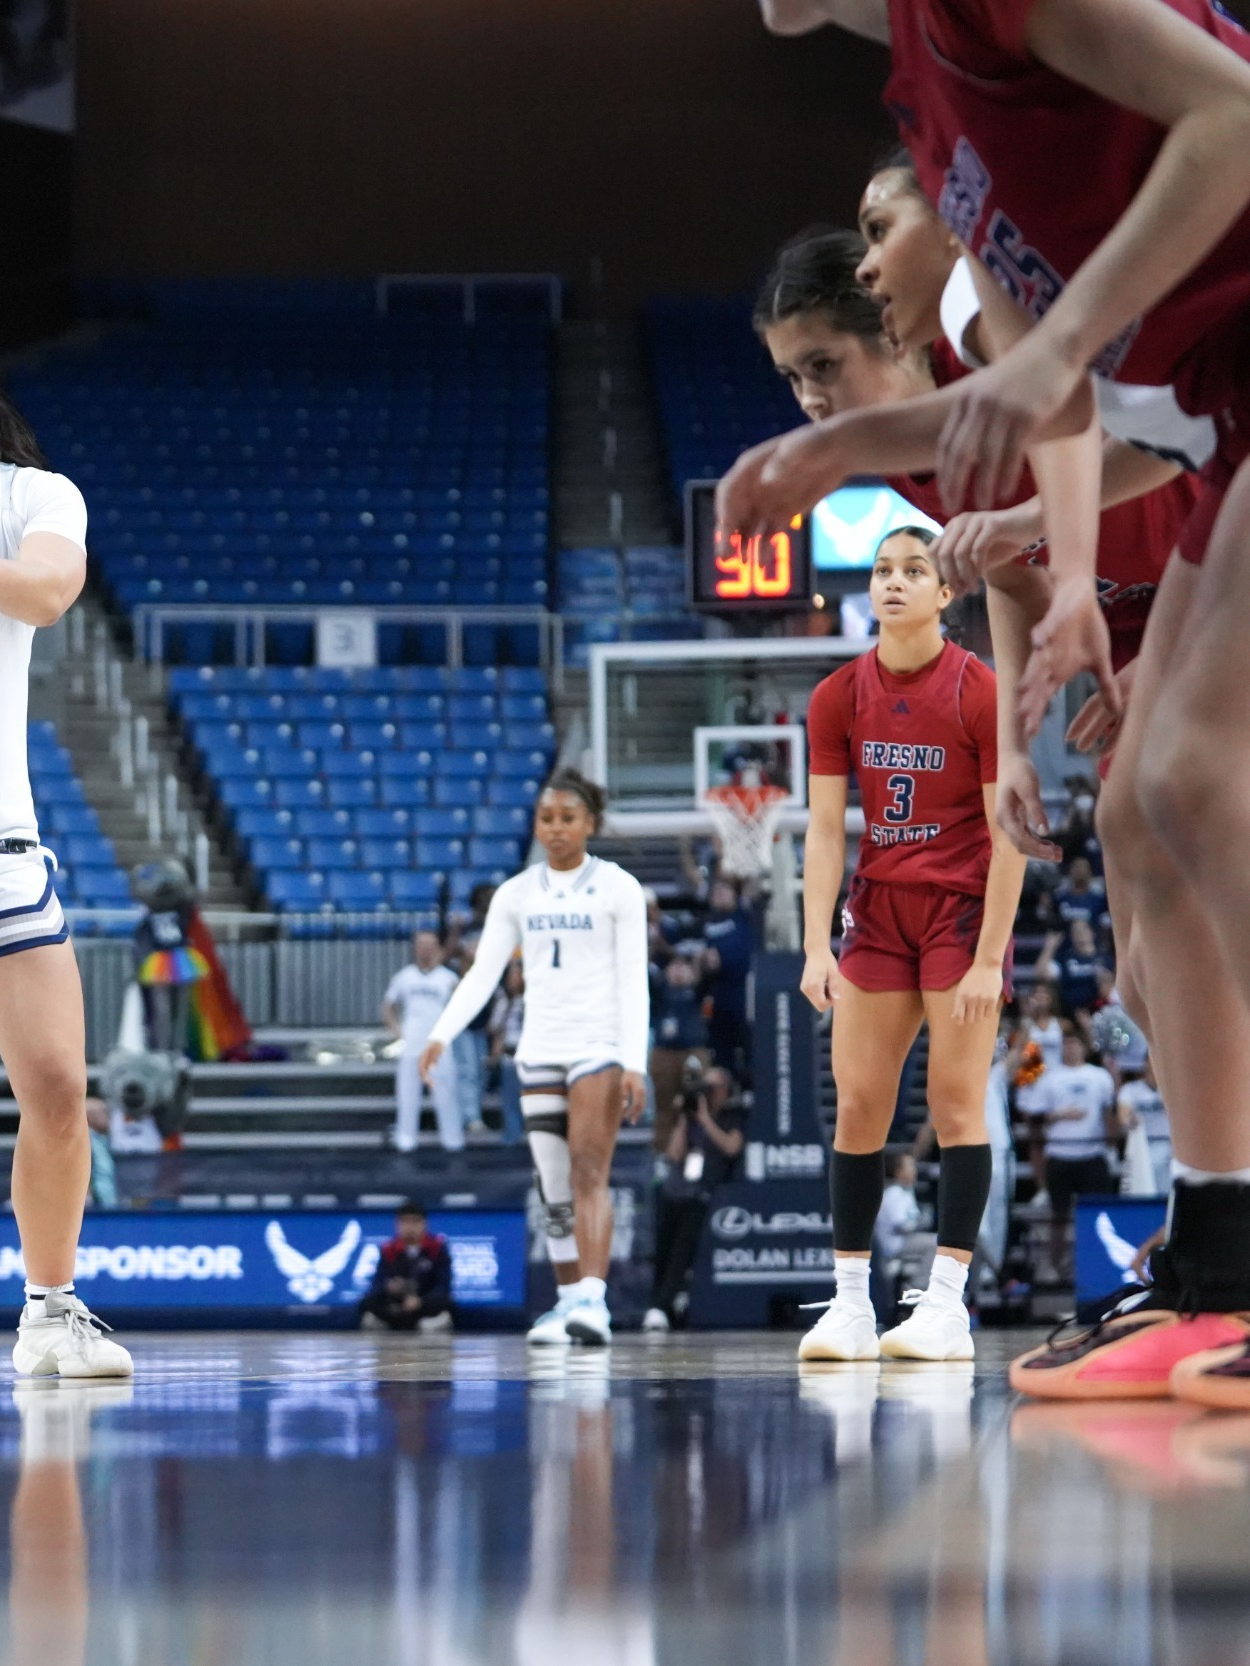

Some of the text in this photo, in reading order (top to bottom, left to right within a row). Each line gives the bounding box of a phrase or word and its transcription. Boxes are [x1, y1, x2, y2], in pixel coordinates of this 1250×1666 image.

[862, 741, 946, 771] FRESNO
[883, 773, 916, 823] 3
[527, 913, 593, 931] NEVADA
[552, 938, 561, 968] 1
[766, 1144, 825, 1168] NSB
[73, 1245, 243, 1280] SPONSOR
[713, 1248, 835, 1269] DOLAN LEX
